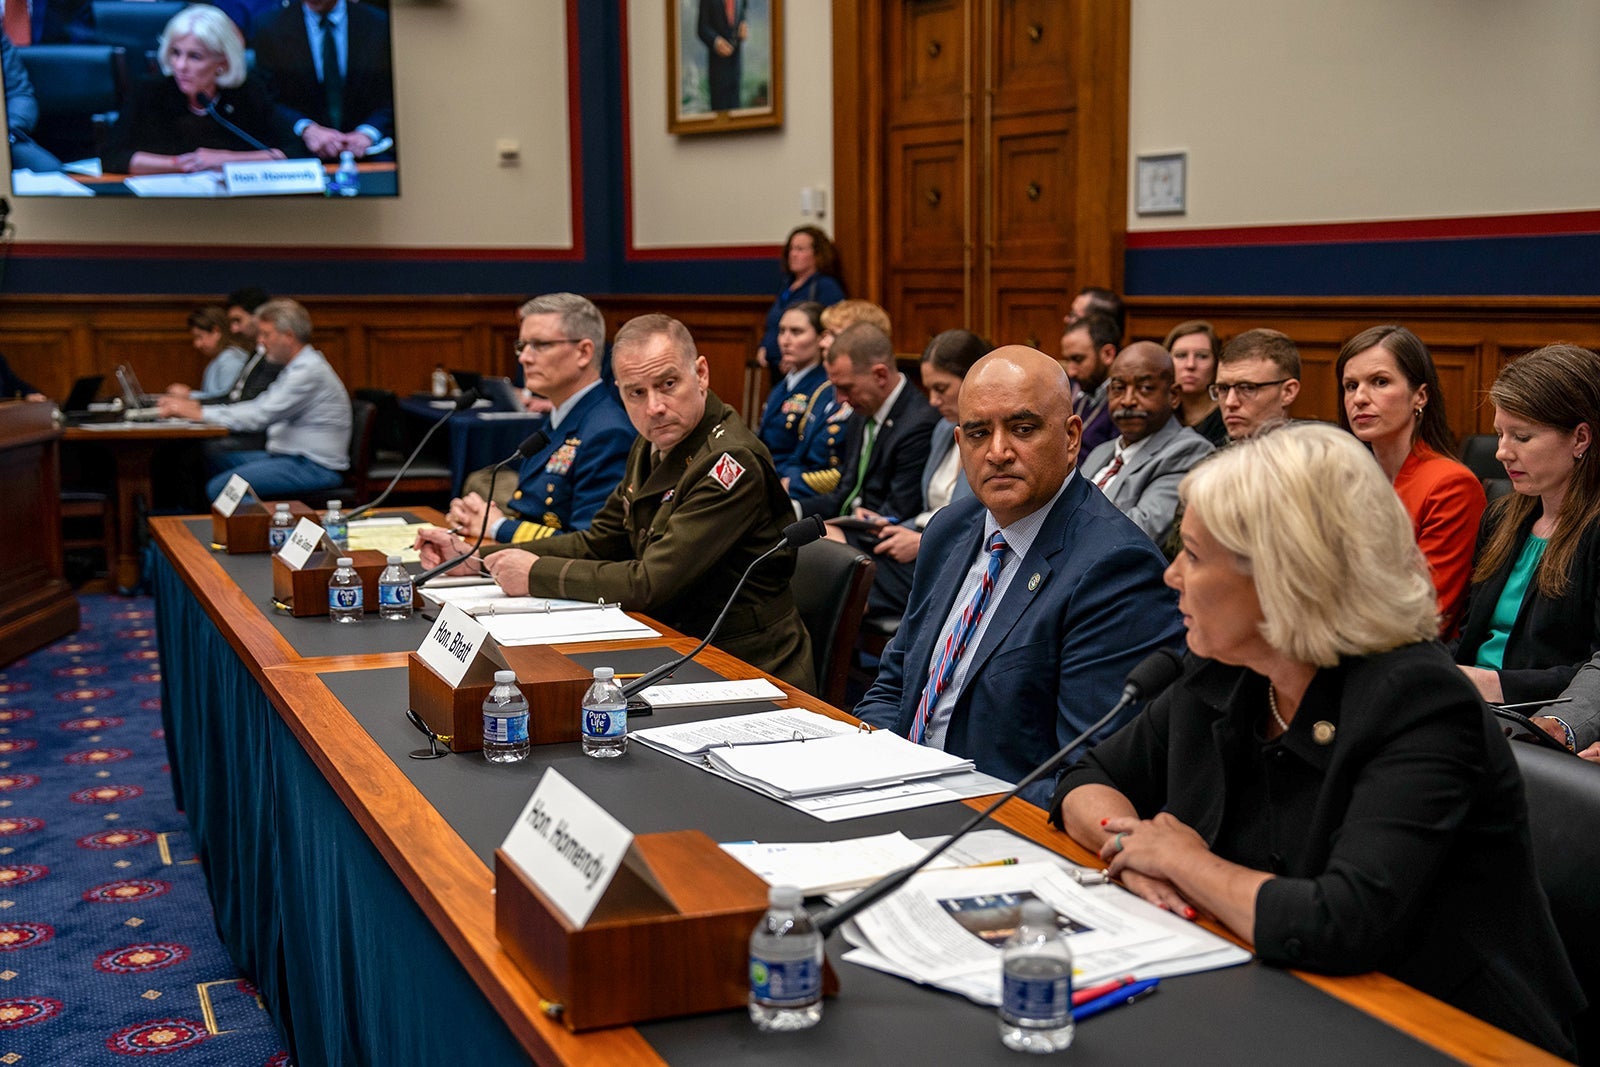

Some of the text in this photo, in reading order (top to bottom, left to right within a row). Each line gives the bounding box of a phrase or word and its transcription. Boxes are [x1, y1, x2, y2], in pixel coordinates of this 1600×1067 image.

[433, 620, 473, 663] Hon. Bhatt
[589, 711, 607, 720] Pure
[590, 718, 605, 728] Life
[525, 798, 608, 891] Hon. Homendy
